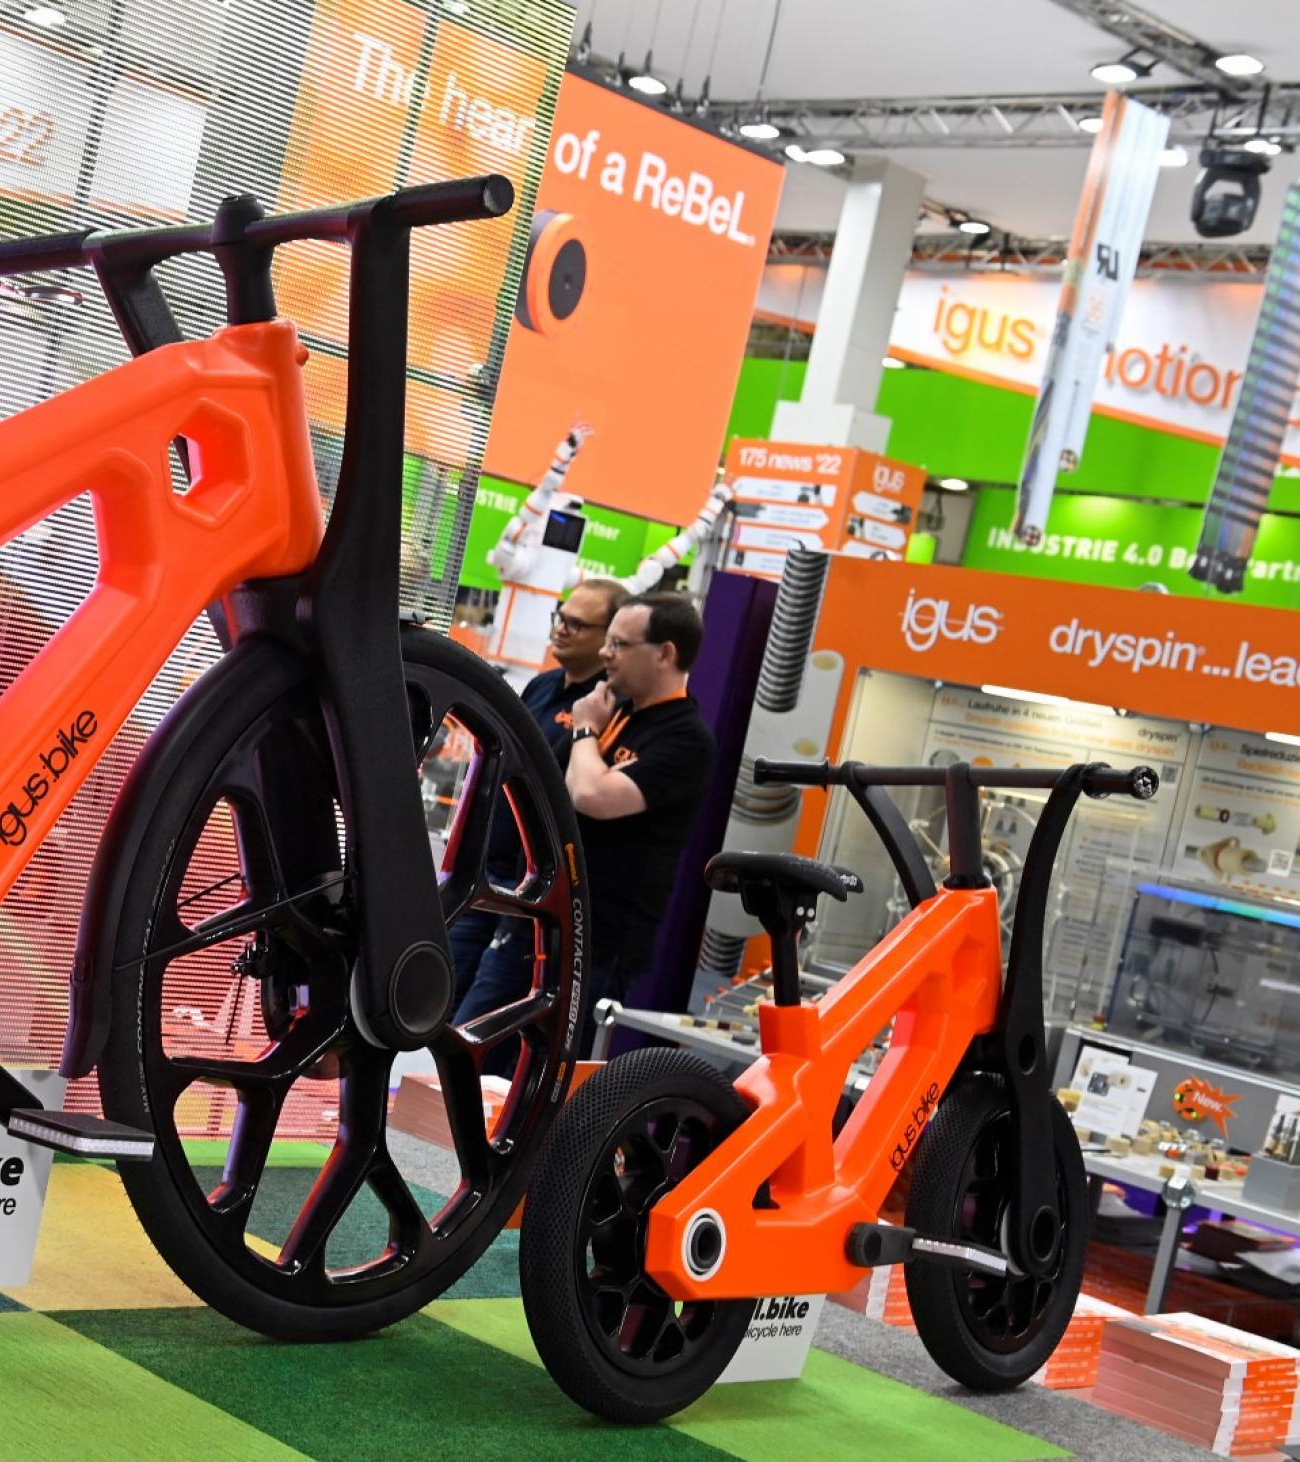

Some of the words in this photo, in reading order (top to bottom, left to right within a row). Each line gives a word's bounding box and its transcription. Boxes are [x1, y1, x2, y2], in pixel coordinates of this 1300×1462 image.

[438, 70, 538, 154] hear
[554, 127, 601, 182] of
[602, 151, 625, 197] a
[933, 286, 1037, 361] igus
[739, 447, 768, 468] 175
[768, 455, 814, 473] news
[1123, 541, 1163, 568] 4.0
[900, 586, 1002, 653] igus
[572, 898, 584, 983] CONTACT
[753, 1296, 810, 1320] l.bike
[779, 1323, 802, 1337] here
